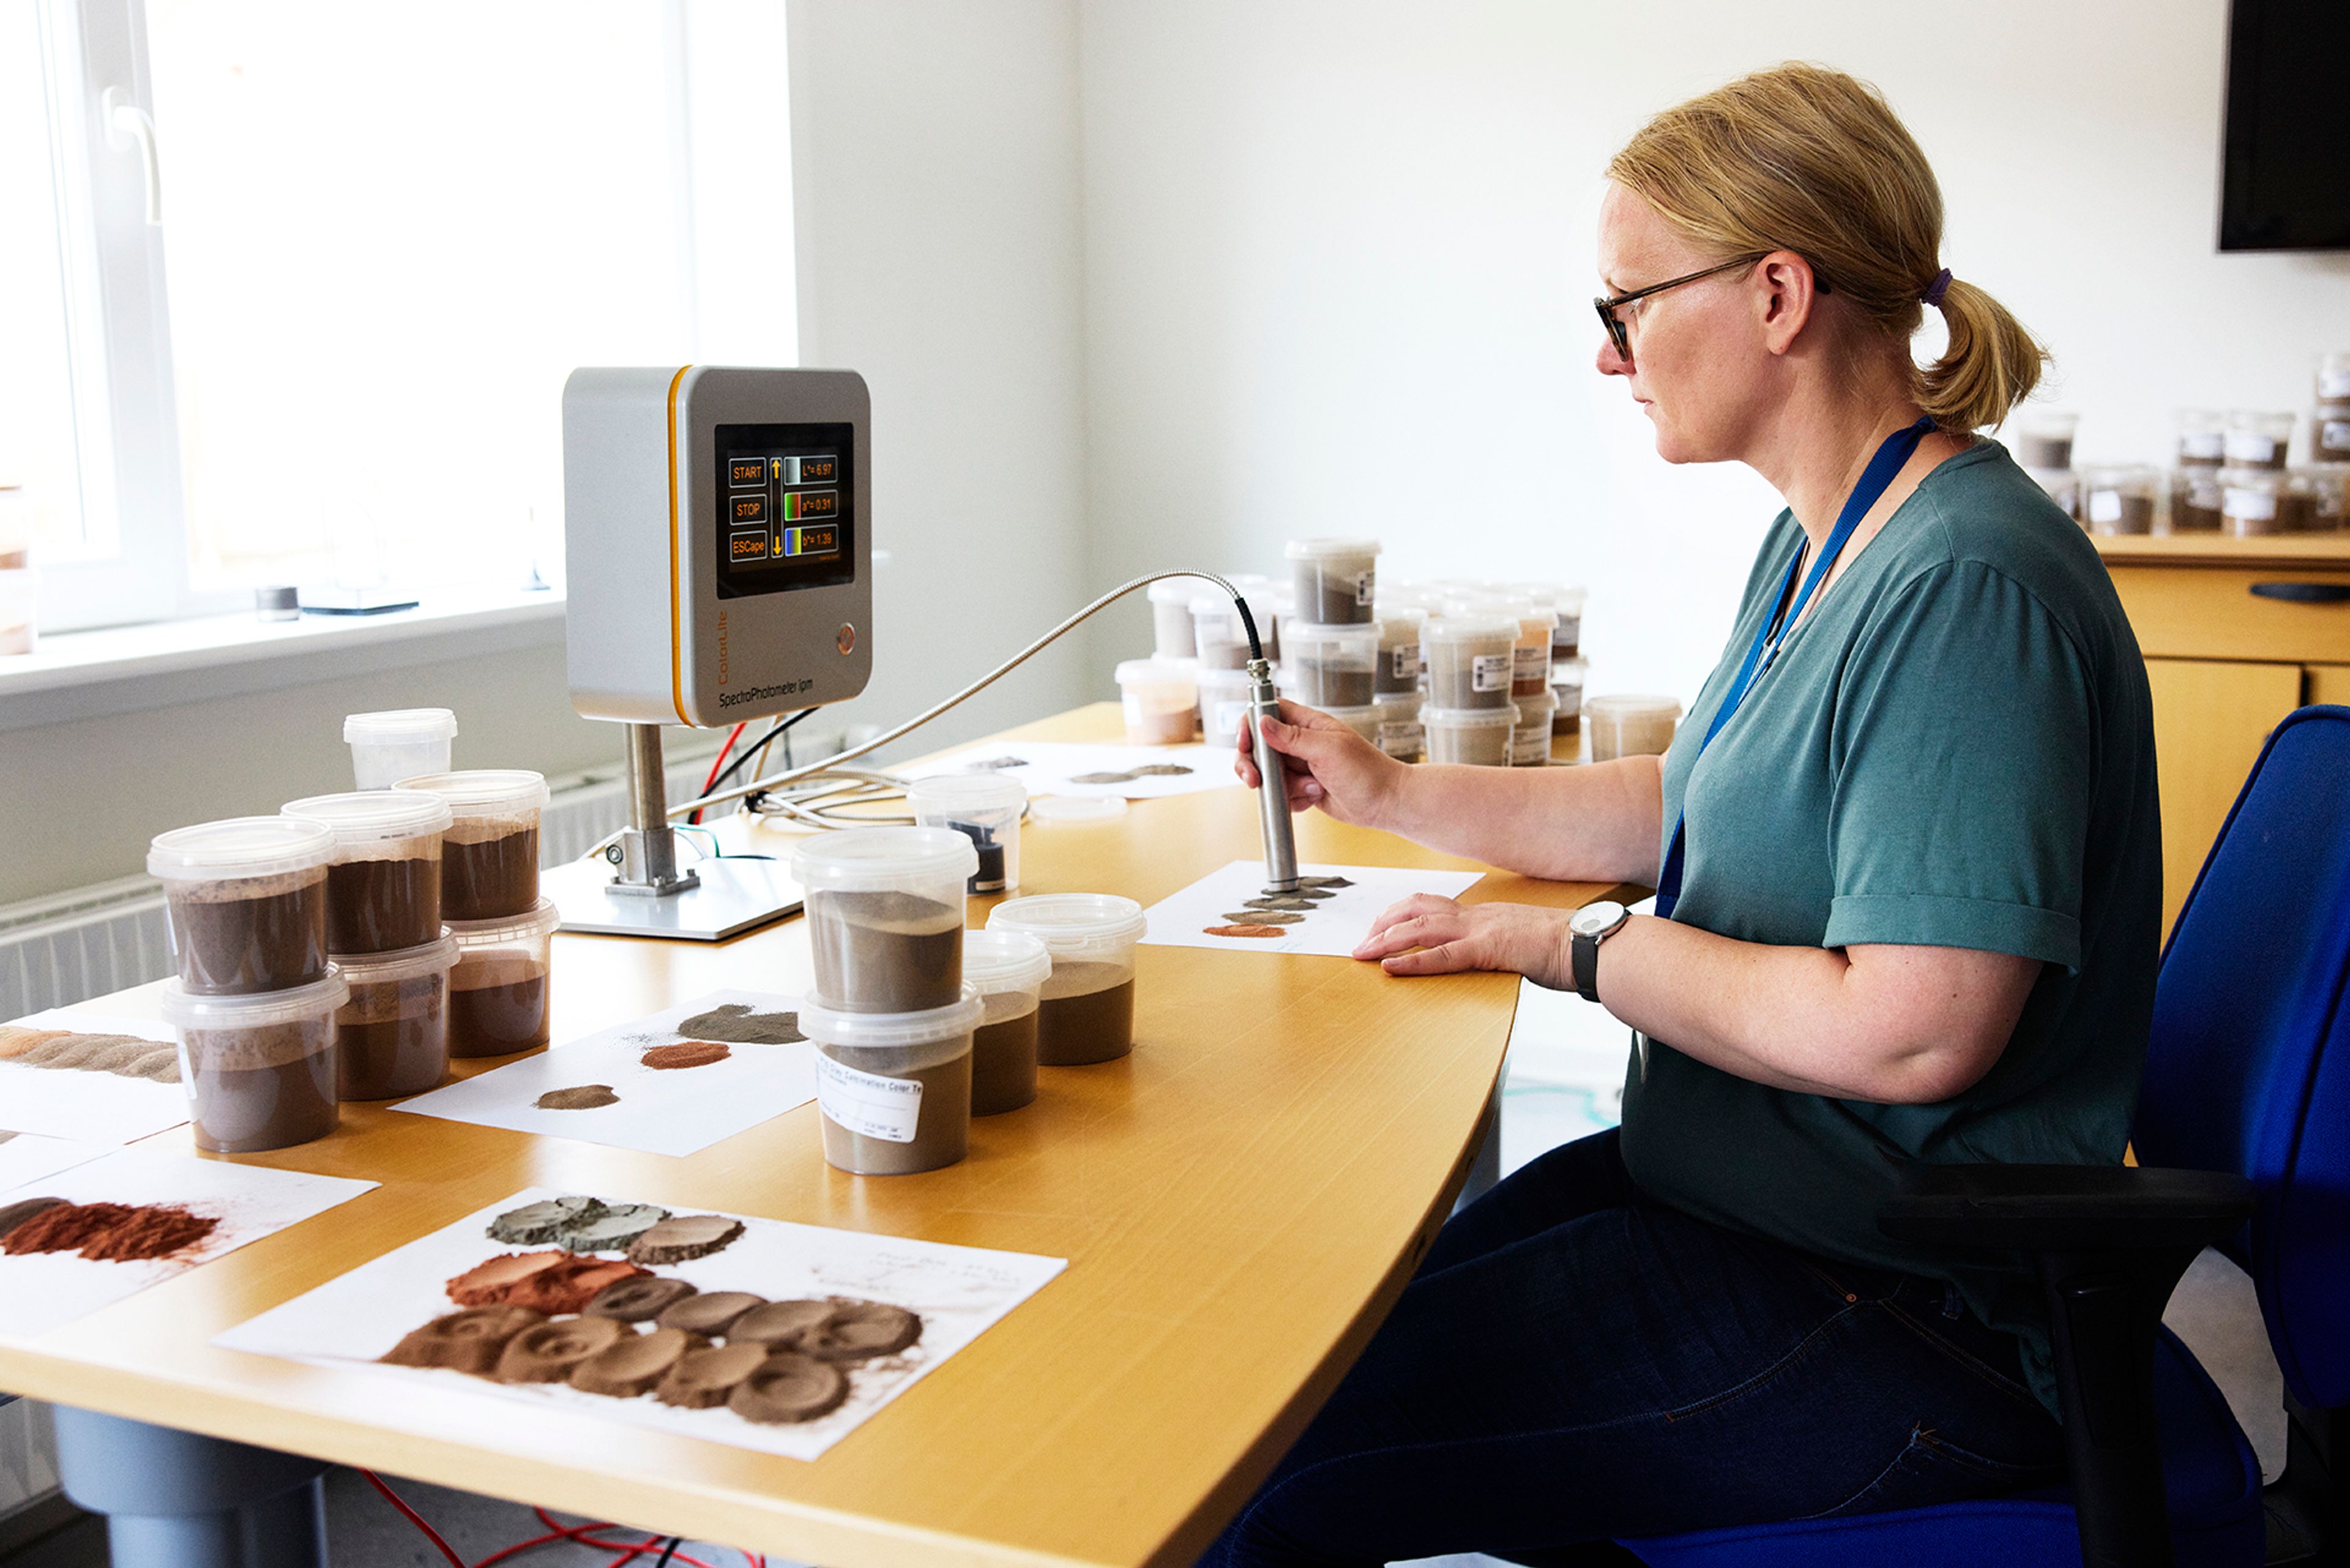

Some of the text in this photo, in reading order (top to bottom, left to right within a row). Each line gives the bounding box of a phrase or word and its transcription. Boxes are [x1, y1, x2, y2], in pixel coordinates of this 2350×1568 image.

[734, 466, 762, 479] START
[816, 463, 832, 476] 6.97
[736, 503, 761, 517] STOP
[815, 498, 831, 510] 0.31
[816, 532, 832, 545] 1.39
[733, 540, 764, 554] ESCape
[718, 610, 728, 685] ColorLite
[718, 680, 797, 709] SpectroPhotometer
[889, 1081, 911, 1093] Color
